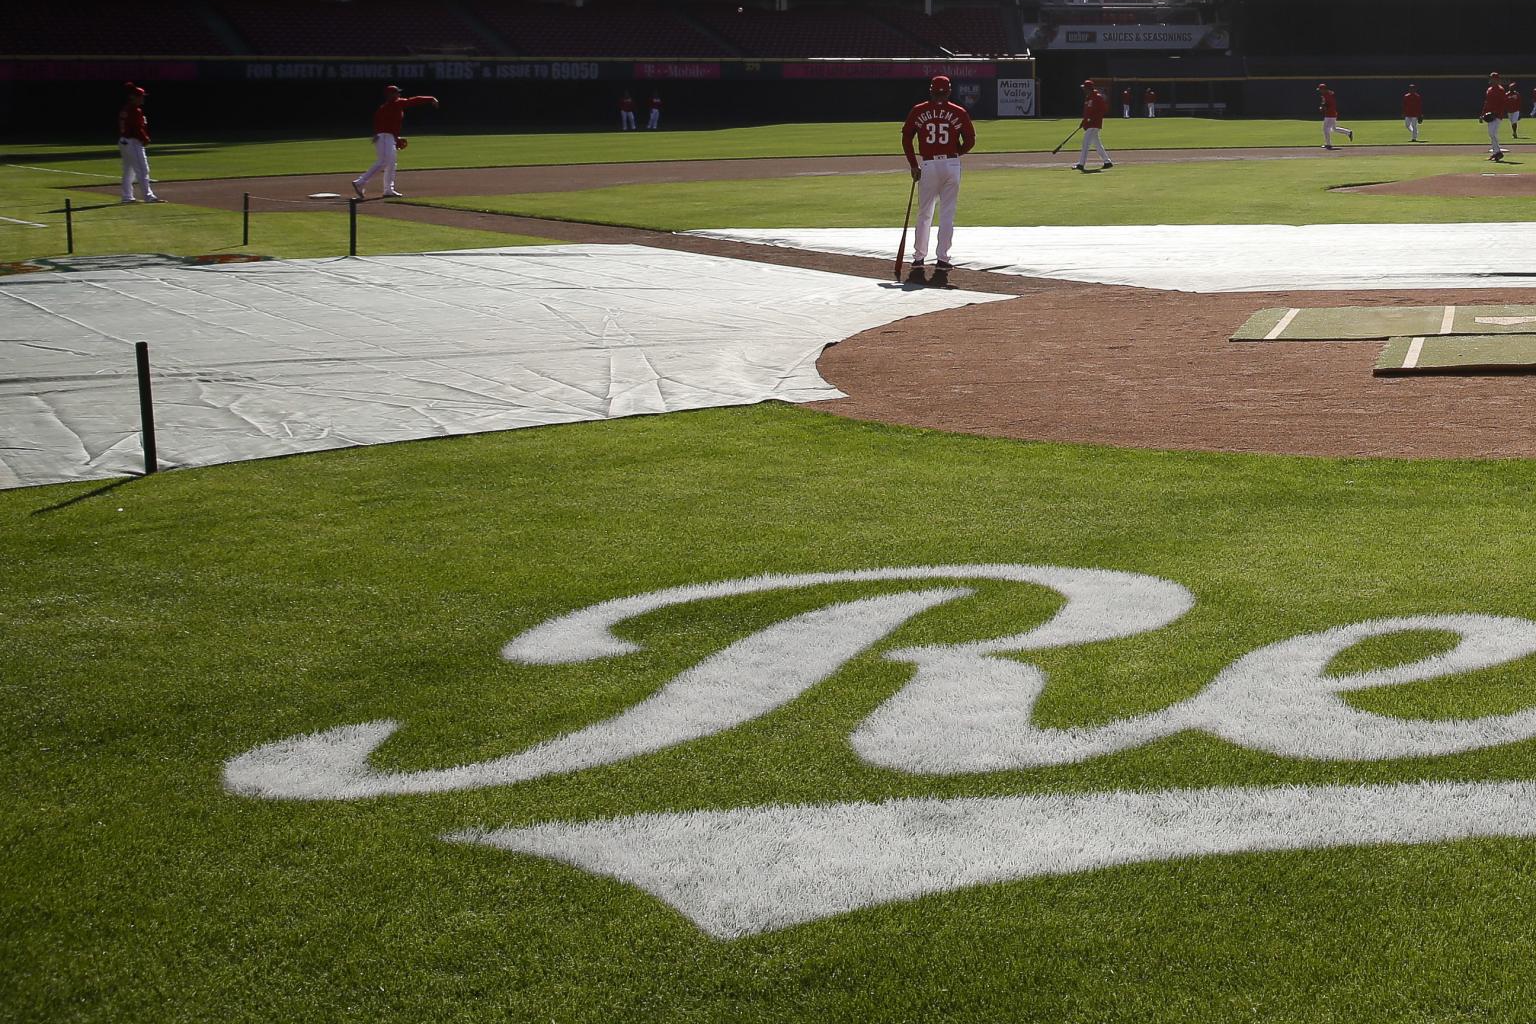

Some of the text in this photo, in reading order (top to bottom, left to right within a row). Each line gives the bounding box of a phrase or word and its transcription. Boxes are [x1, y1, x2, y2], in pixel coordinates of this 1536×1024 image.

[1103, 32, 1193, 43] SAUCES & SEASONINGS
[246, 63, 273, 79] FOR
[276, 63, 324, 79] SAFETY
[340, 63, 394, 79] SERVICE
[396, 63, 425, 78] TEXT
[496, 64, 530, 79] ISSUE
[533, 64, 550, 79] TO
[552, 62, 600, 80] 69050
[1000, 79, 1030, 88] Miami
[1003, 88, 1032, 100] Valley
[926, 123, 950, 145] 35
